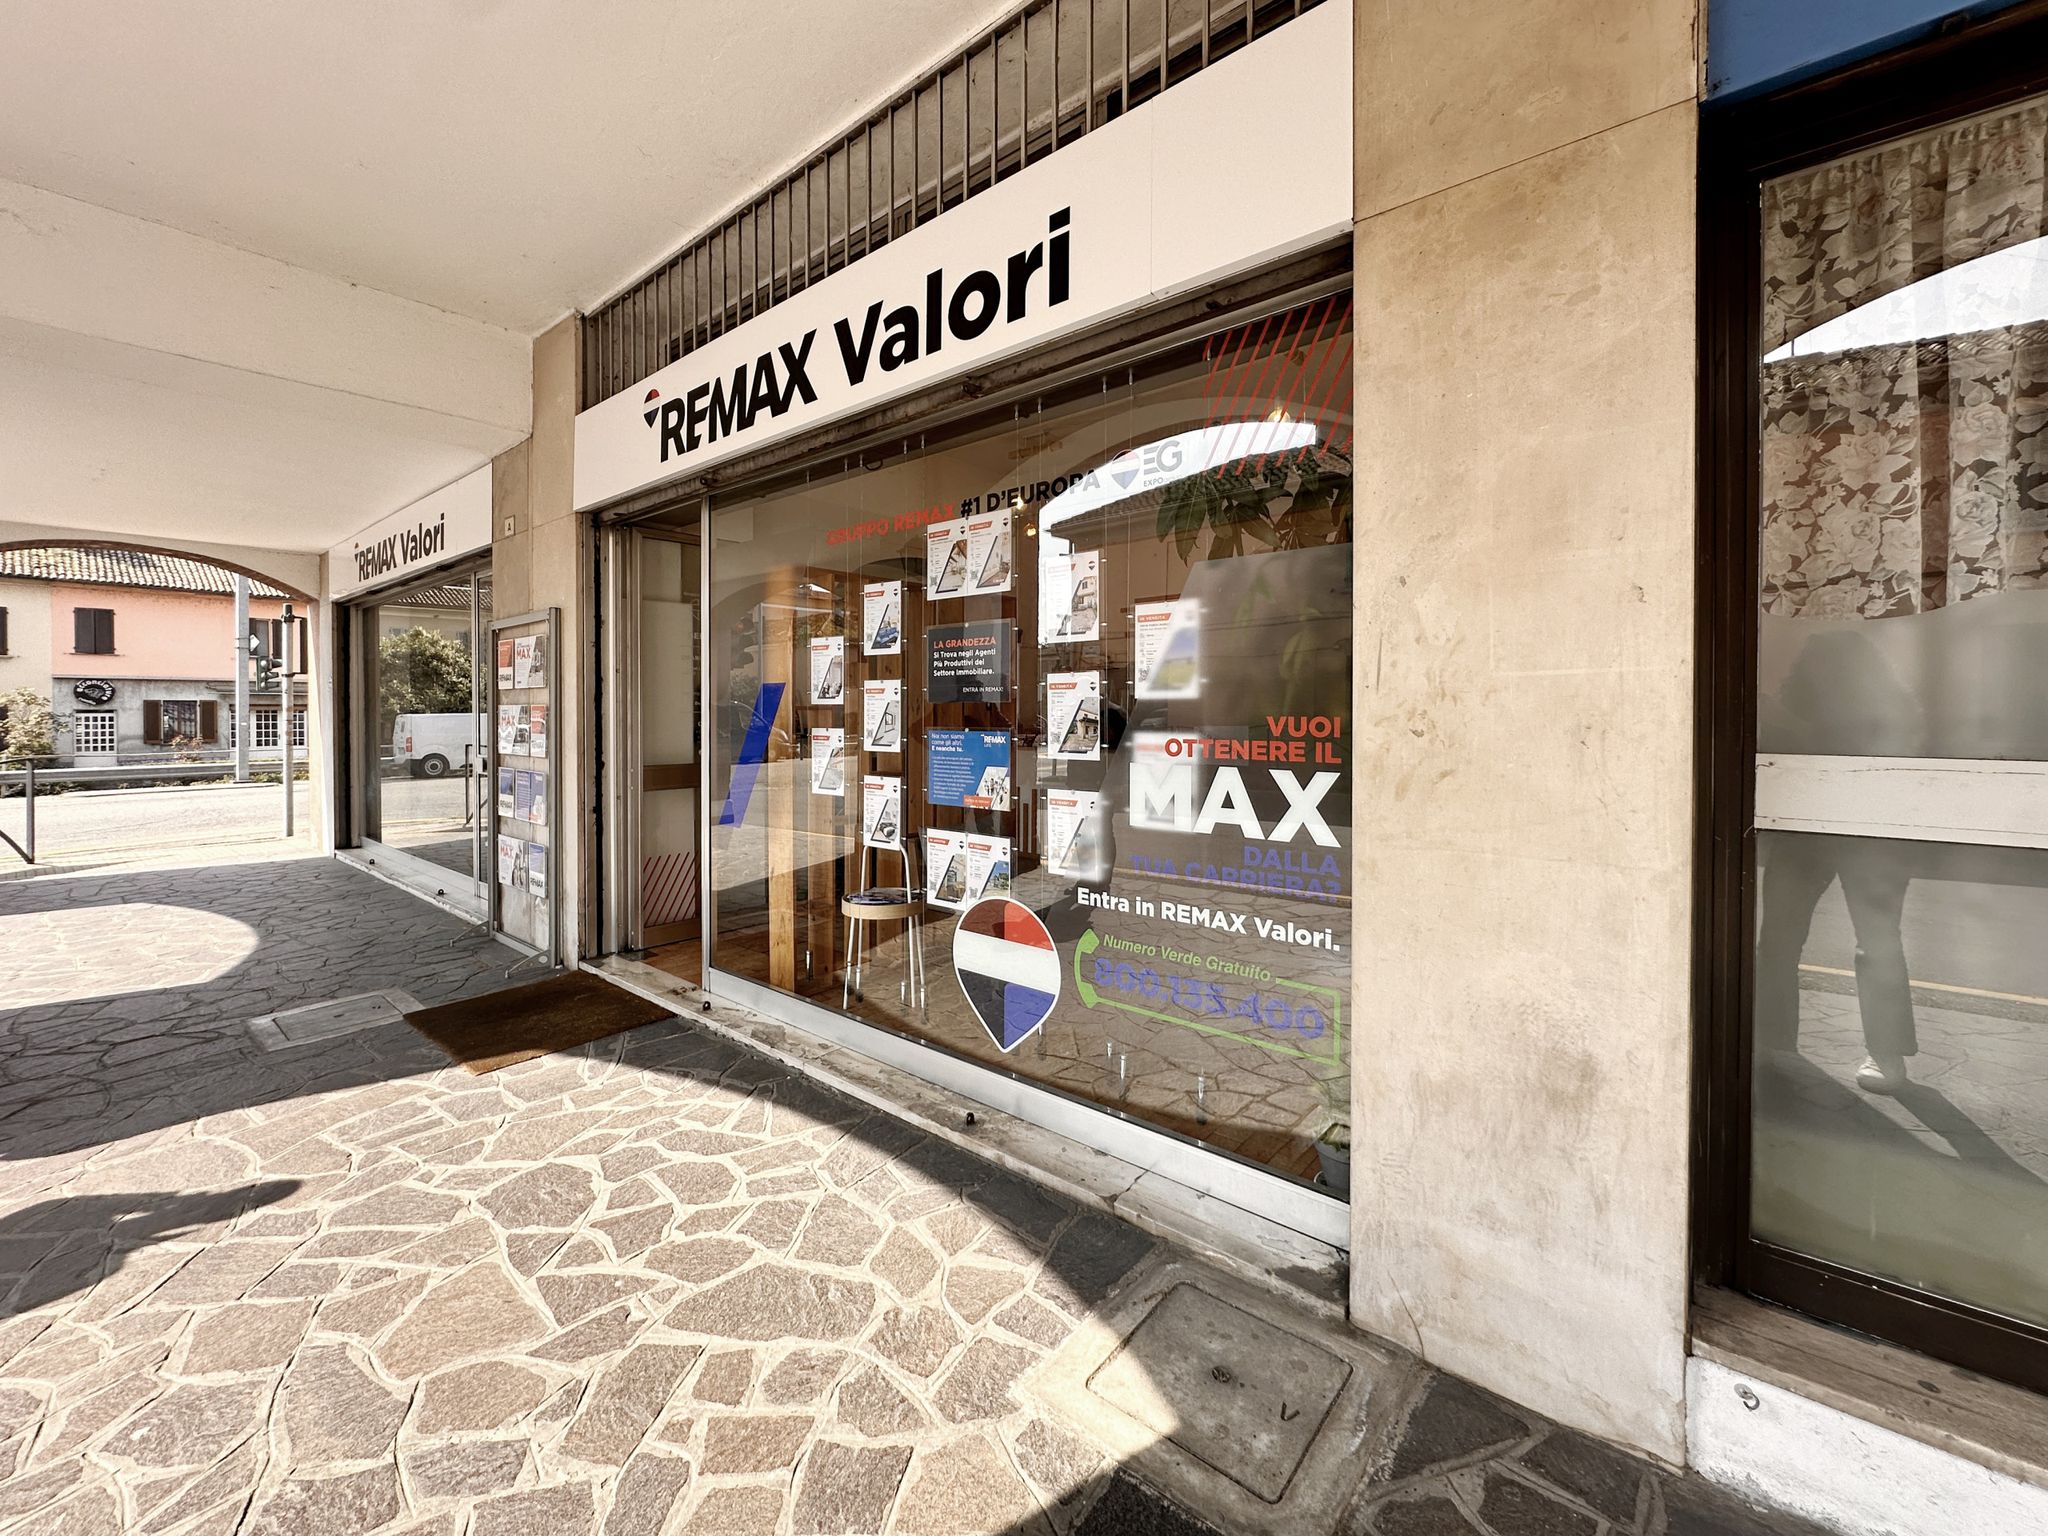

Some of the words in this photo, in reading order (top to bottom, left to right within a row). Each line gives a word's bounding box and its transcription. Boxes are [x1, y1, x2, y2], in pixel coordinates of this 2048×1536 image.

[660, 328, 818, 464] REMAX
[834, 206, 1071, 387] Valori
[1143, 477, 1164, 488] EXPO
[826, 518, 889, 546] GRUPPO
[960, 496, 981, 518] #1
[987, 468, 1100, 513] D'EUROPA
[358, 534, 397, 583] REMAX
[400, 512, 445, 565] Valori
[933, 641, 944, 649] LA
[945, 636, 997, 648] GRANDEZZA
[941, 651, 957, 659] Trova
[958, 650, 974, 659] negli
[975, 648, 996, 657] Agenti
[933, 668, 955, 677] Settore
[956, 667, 995, 676] Immobiliare.
[944, 658, 974, 668] Produttivi
[974, 658, 985, 666] del
[1266, 715, 1341, 738] VUOI
[1164, 738, 1307, 763] OTTENERE
[1315, 742, 1342, 764] IL
[1129, 762, 1342, 848] MAX
[1130, 854, 1177, 880] TUA
[1244, 846, 1341, 878] DALLA
[1077, 887, 1129, 913] Entra
[1135, 896, 1154, 917] in
[1161, 901, 1247, 935] REMAX
[1254, 916, 1340, 951] Valori.
[1104, 934, 1156, 957] Numero
[1160, 946, 1202, 967] Verde
[1206, 956, 1271, 982] Gratuito
